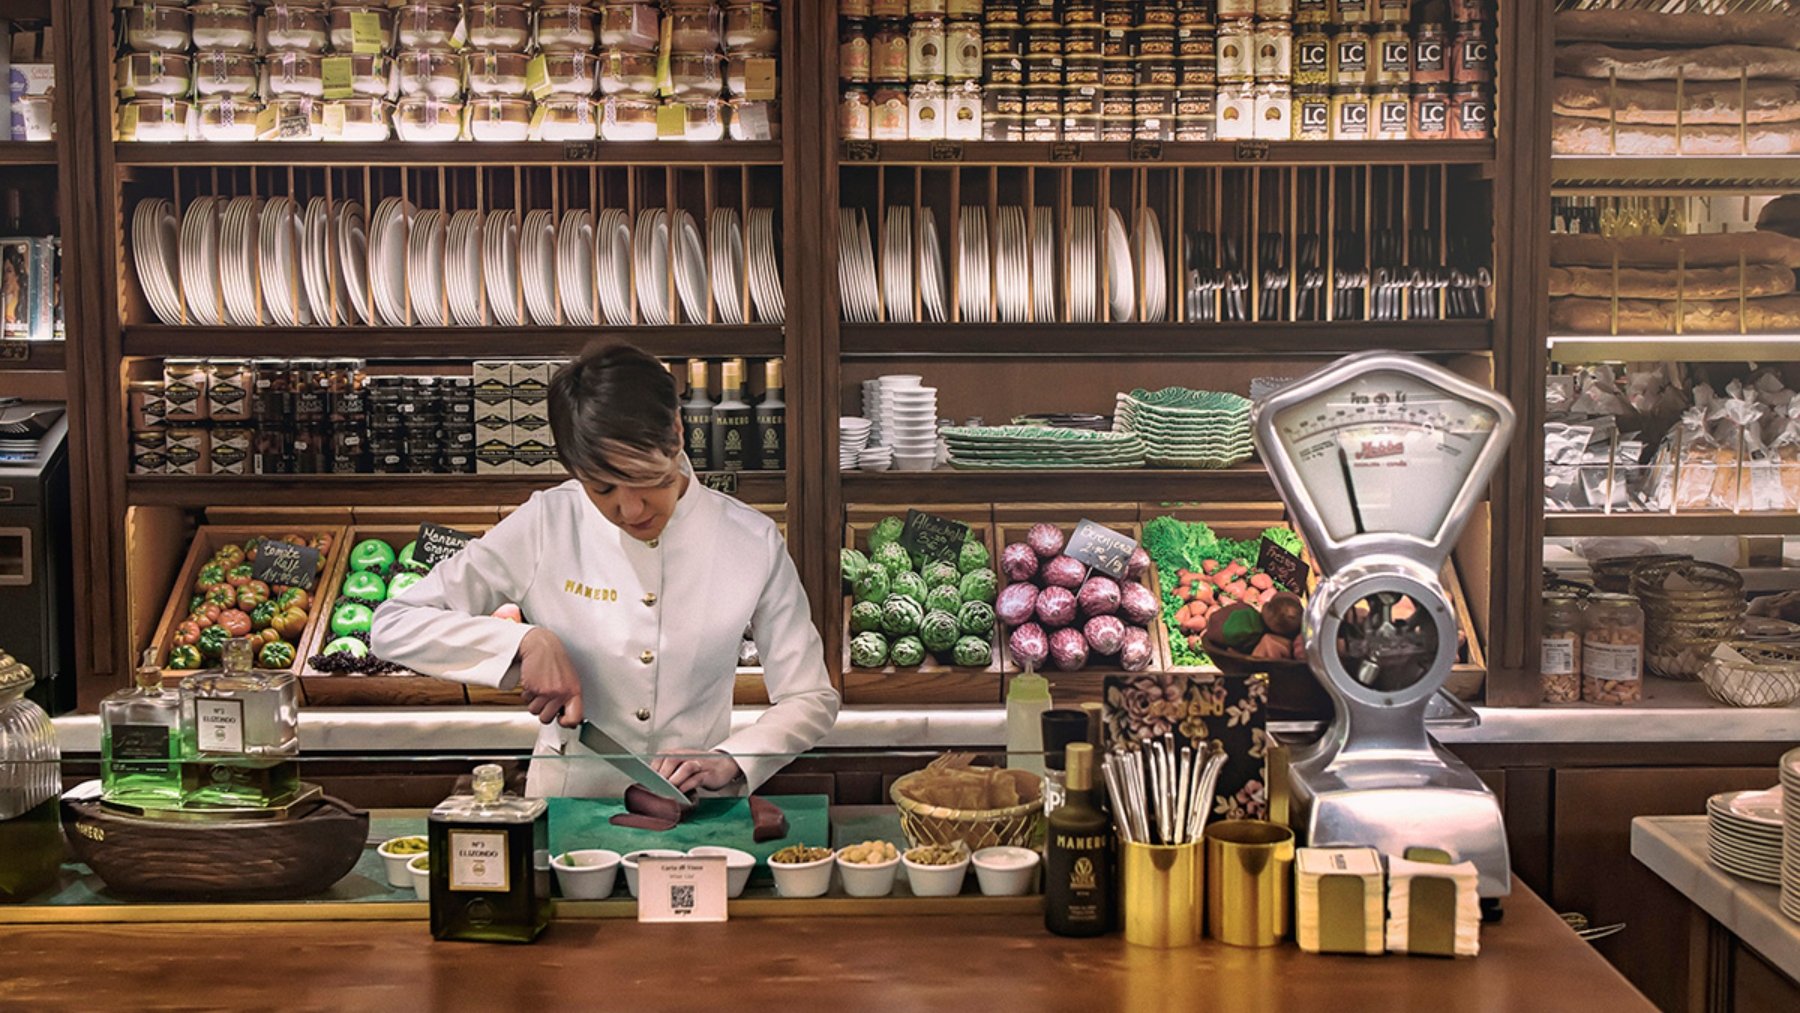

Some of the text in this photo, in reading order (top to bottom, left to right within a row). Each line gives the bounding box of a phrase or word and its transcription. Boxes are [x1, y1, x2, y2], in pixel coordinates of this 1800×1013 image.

[1302, 46, 1324, 64] LC
[1341, 45, 1364, 63] LC
[1386, 45, 1407, 62] LC
[1418, 44, 1441, 62] LC
[1465, 44, 1487, 61] LC
[1304, 107, 1326, 124] LC
[1343, 106, 1366, 123] LC
[1383, 106, 1405, 122] LC
[1421, 106, 1444, 122] LC
[1463, 106, 1486, 122] LC
[564, 579, 618, 602] MANERO
